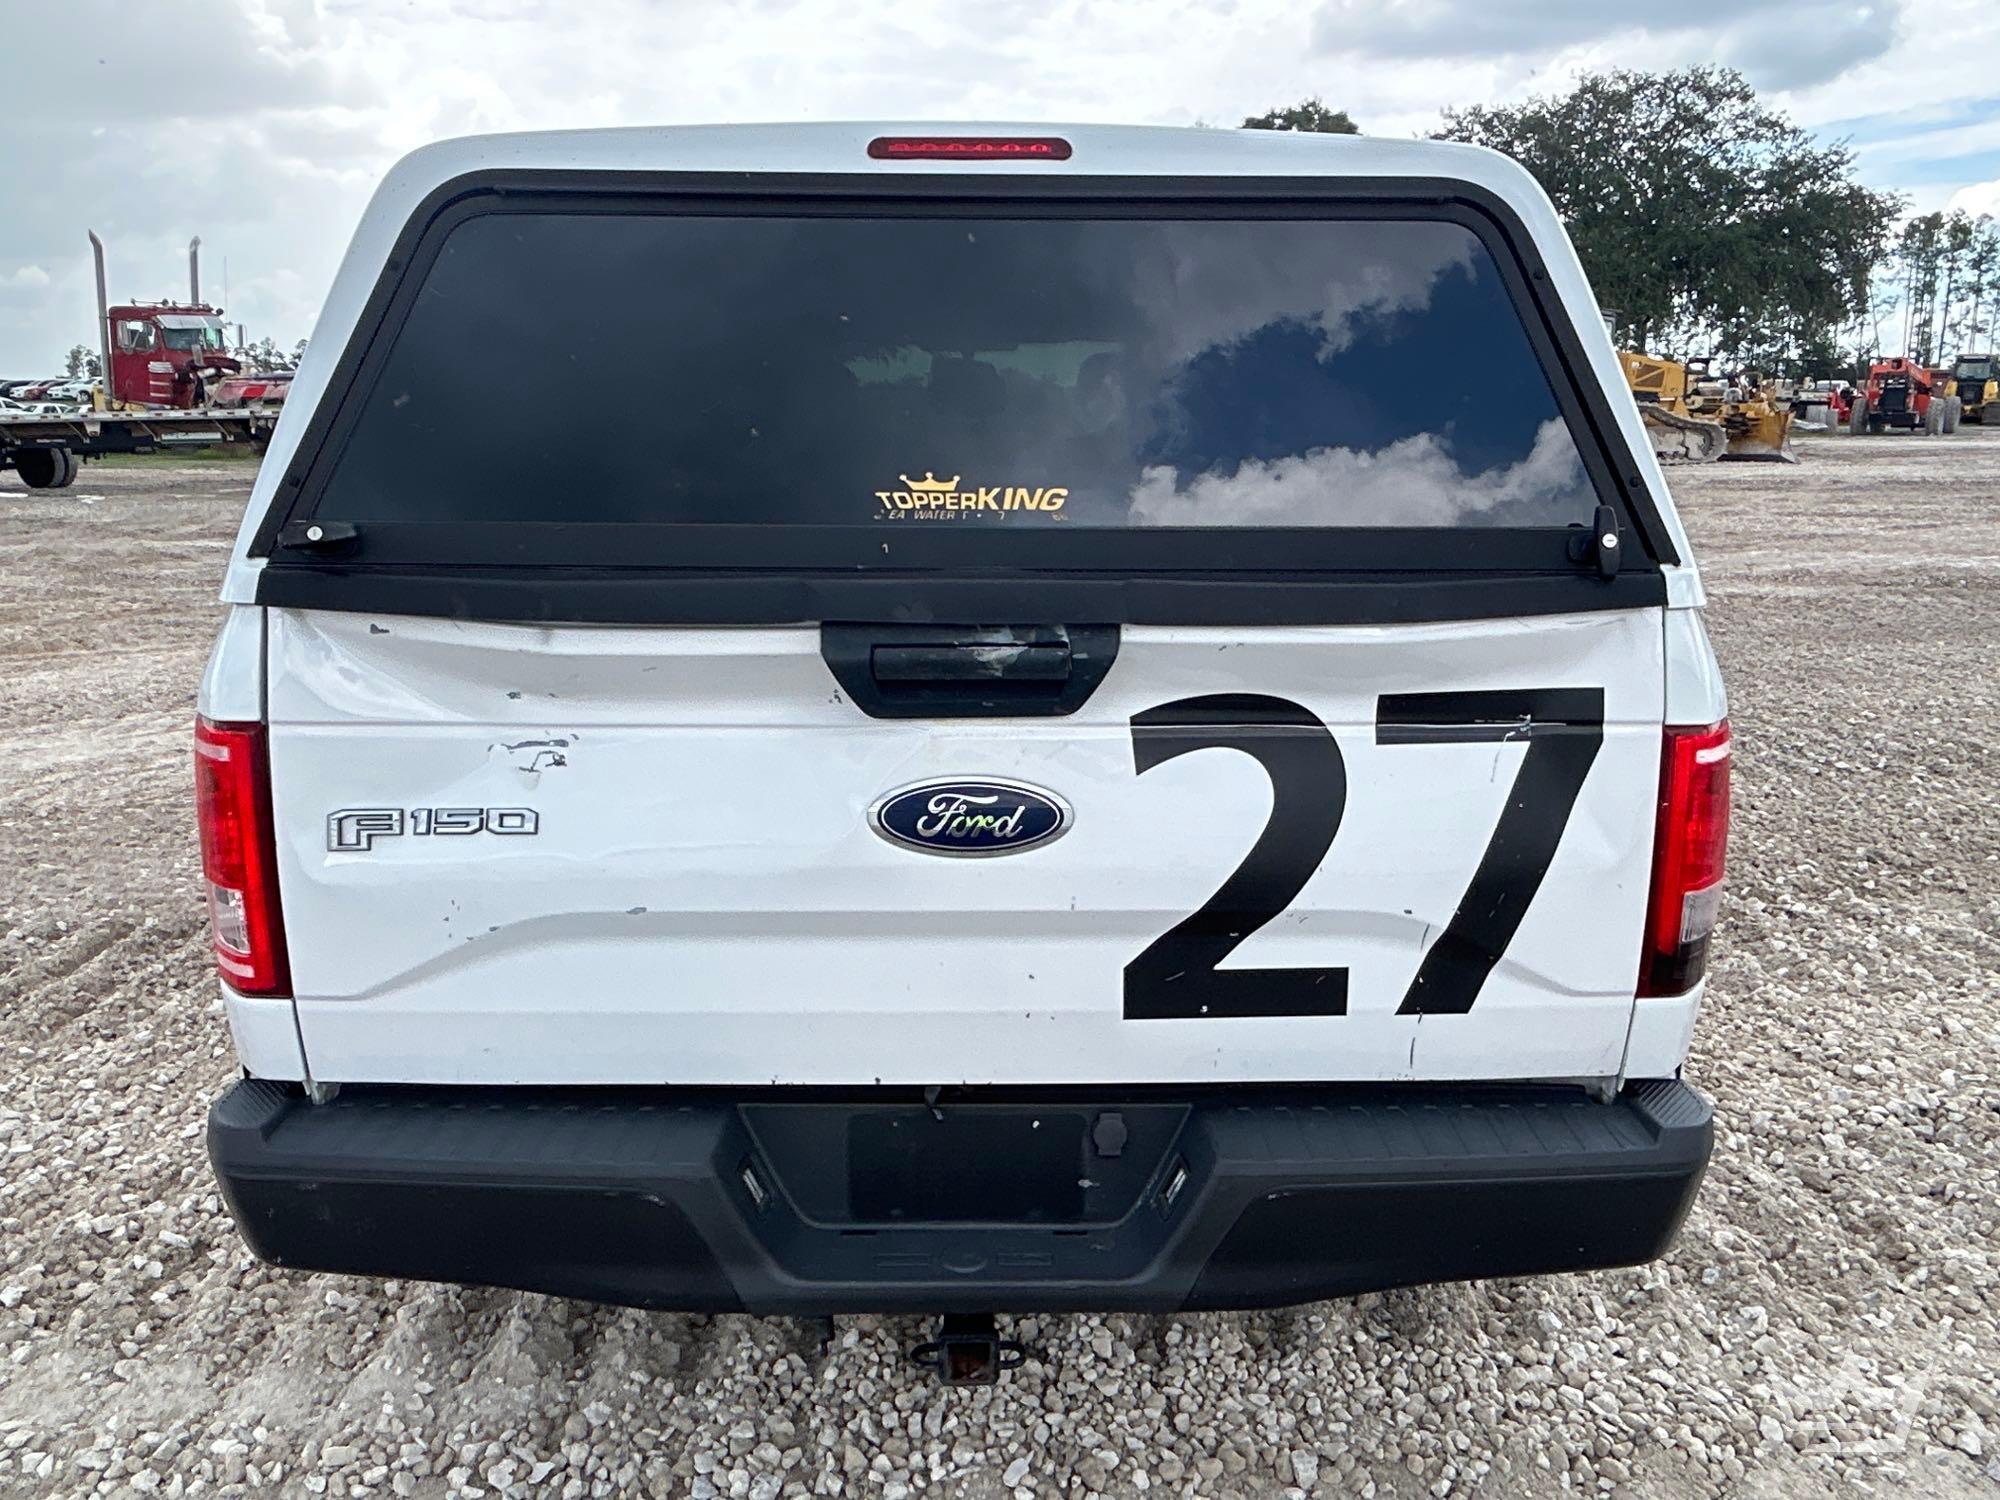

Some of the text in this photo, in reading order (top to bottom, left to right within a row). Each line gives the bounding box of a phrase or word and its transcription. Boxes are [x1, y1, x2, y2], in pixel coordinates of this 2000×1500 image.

[326, 807, 540, 852] F150
[916, 793, 1026, 839] Ford
[1123, 688, 1604, 1019] 27
